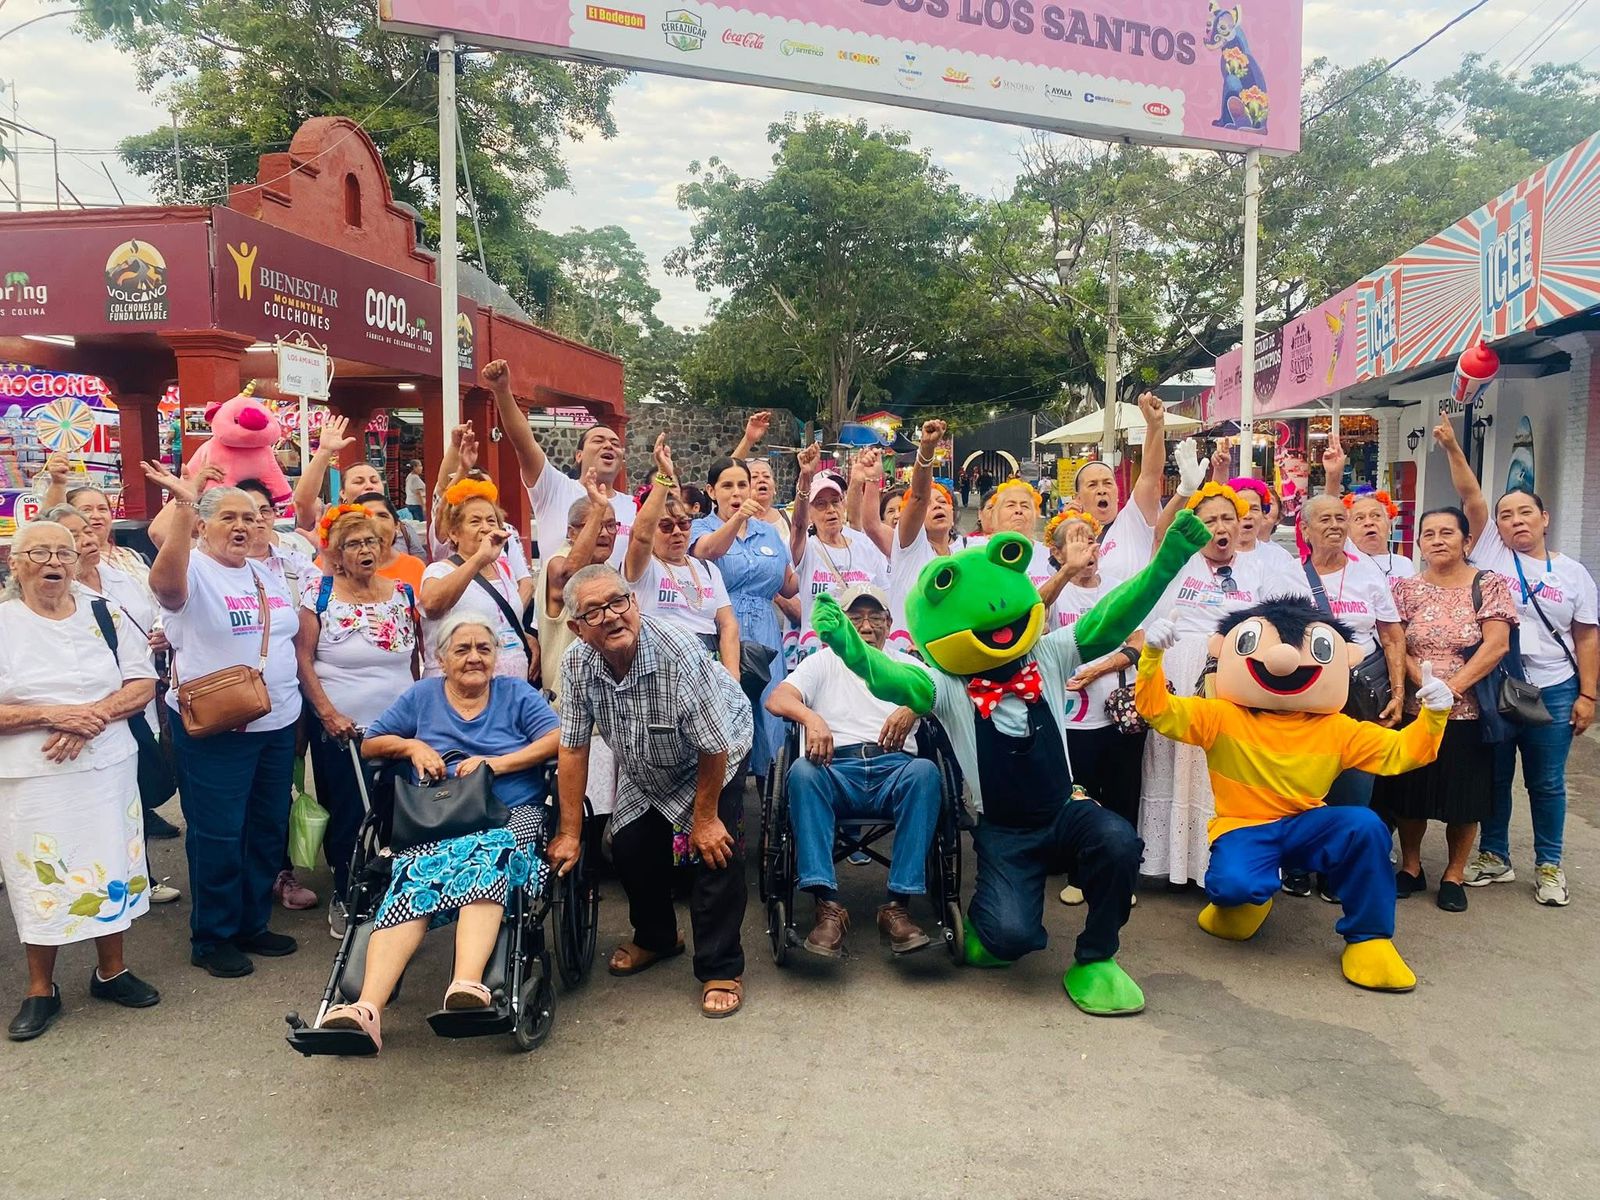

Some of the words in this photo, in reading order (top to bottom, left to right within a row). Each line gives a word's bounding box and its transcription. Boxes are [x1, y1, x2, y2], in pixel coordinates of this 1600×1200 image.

[588, 7, 598, 19] El
[599, 10, 643, 27] Bodegón
[661, 23, 707, 39] CEREAZUCAR
[957, 0, 1034, 35] LOS
[1041, 4, 1196, 66] SANTOS
[945, 67, 967, 79] Sur
[1051, 87, 1072, 97] AYALA
[1149, 104, 1168, 115] cmic
[1486, 211, 1534, 318] ICEE
[107, 285, 167, 302] VOLCANO
[259, 267, 338, 308] BIENESTAR
[12, 308, 46, 316] COLIMA
[111, 303, 151, 312] COLCHONES
[153, 302, 163, 311] DE
[274, 294, 324, 315] MOMENTUM
[110, 312, 134, 321] FUNDA
[135, 310, 168, 321] LAVABLE
[264, 301, 330, 331] COLCHONES
[365, 288, 406, 334] COCO
[406, 320, 433, 346] Spring
[1368, 287, 1397, 361] ICEE
[658, 589, 678, 602] DIF
[811, 582, 829, 595] DIF
[1177, 587, 1200, 601] DIF
[229, 610, 252, 627] DIF
